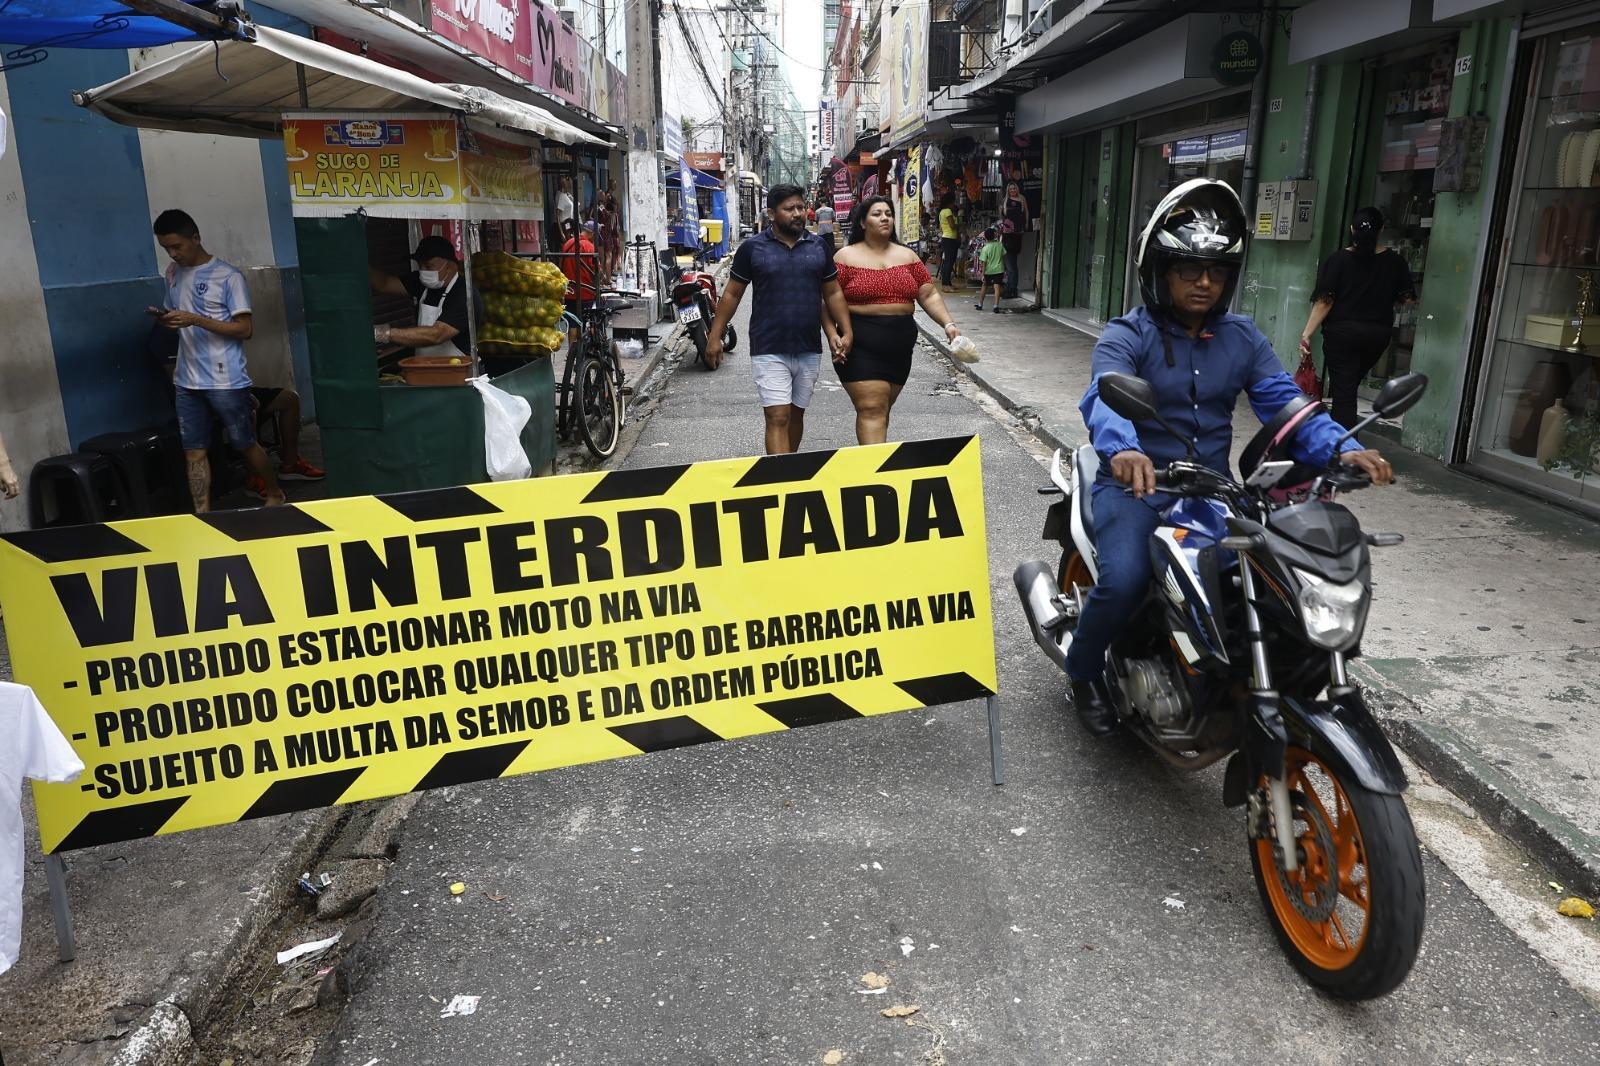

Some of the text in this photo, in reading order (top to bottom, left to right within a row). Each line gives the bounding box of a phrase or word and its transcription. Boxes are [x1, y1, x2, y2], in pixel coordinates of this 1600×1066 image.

[1221, 58, 1257, 69] mundial
[294, 171, 444, 198] LARANJA
[316, 153, 400, 170] SUCO DE
[49, 477, 964, 648] VIA INTERDITADA
[86, 638, 270, 696] PROIBIDO
[278, 610, 492, 668] ESTACIONAR
[499, 596, 591, 638] MOTO
[600, 590, 643, 624] NA
[647, 583, 701, 617] VIA
[95, 688, 277, 747] PROIBIDO
[287, 665, 446, 717] COLOCAR
[454, 640, 618, 694] QUALQUER
[624, 629, 695, 667] TIPO
[703, 623, 739, 657] DE
[746, 604, 881, 650] BARRACA
[887, 598, 923, 630] NA
[928, 591, 975, 624] VIA
[255, 739, 278, 774] A
[284, 720, 398, 768] MULTA
[403, 712, 451, 749] DA
[457, 695, 570, 740] SEMOB
[578, 690, 594, 721] E
[601, 683, 644, 718] DA
[651, 666, 755, 710] ORDEM
[762, 648, 883, 693] PÚBLICA
